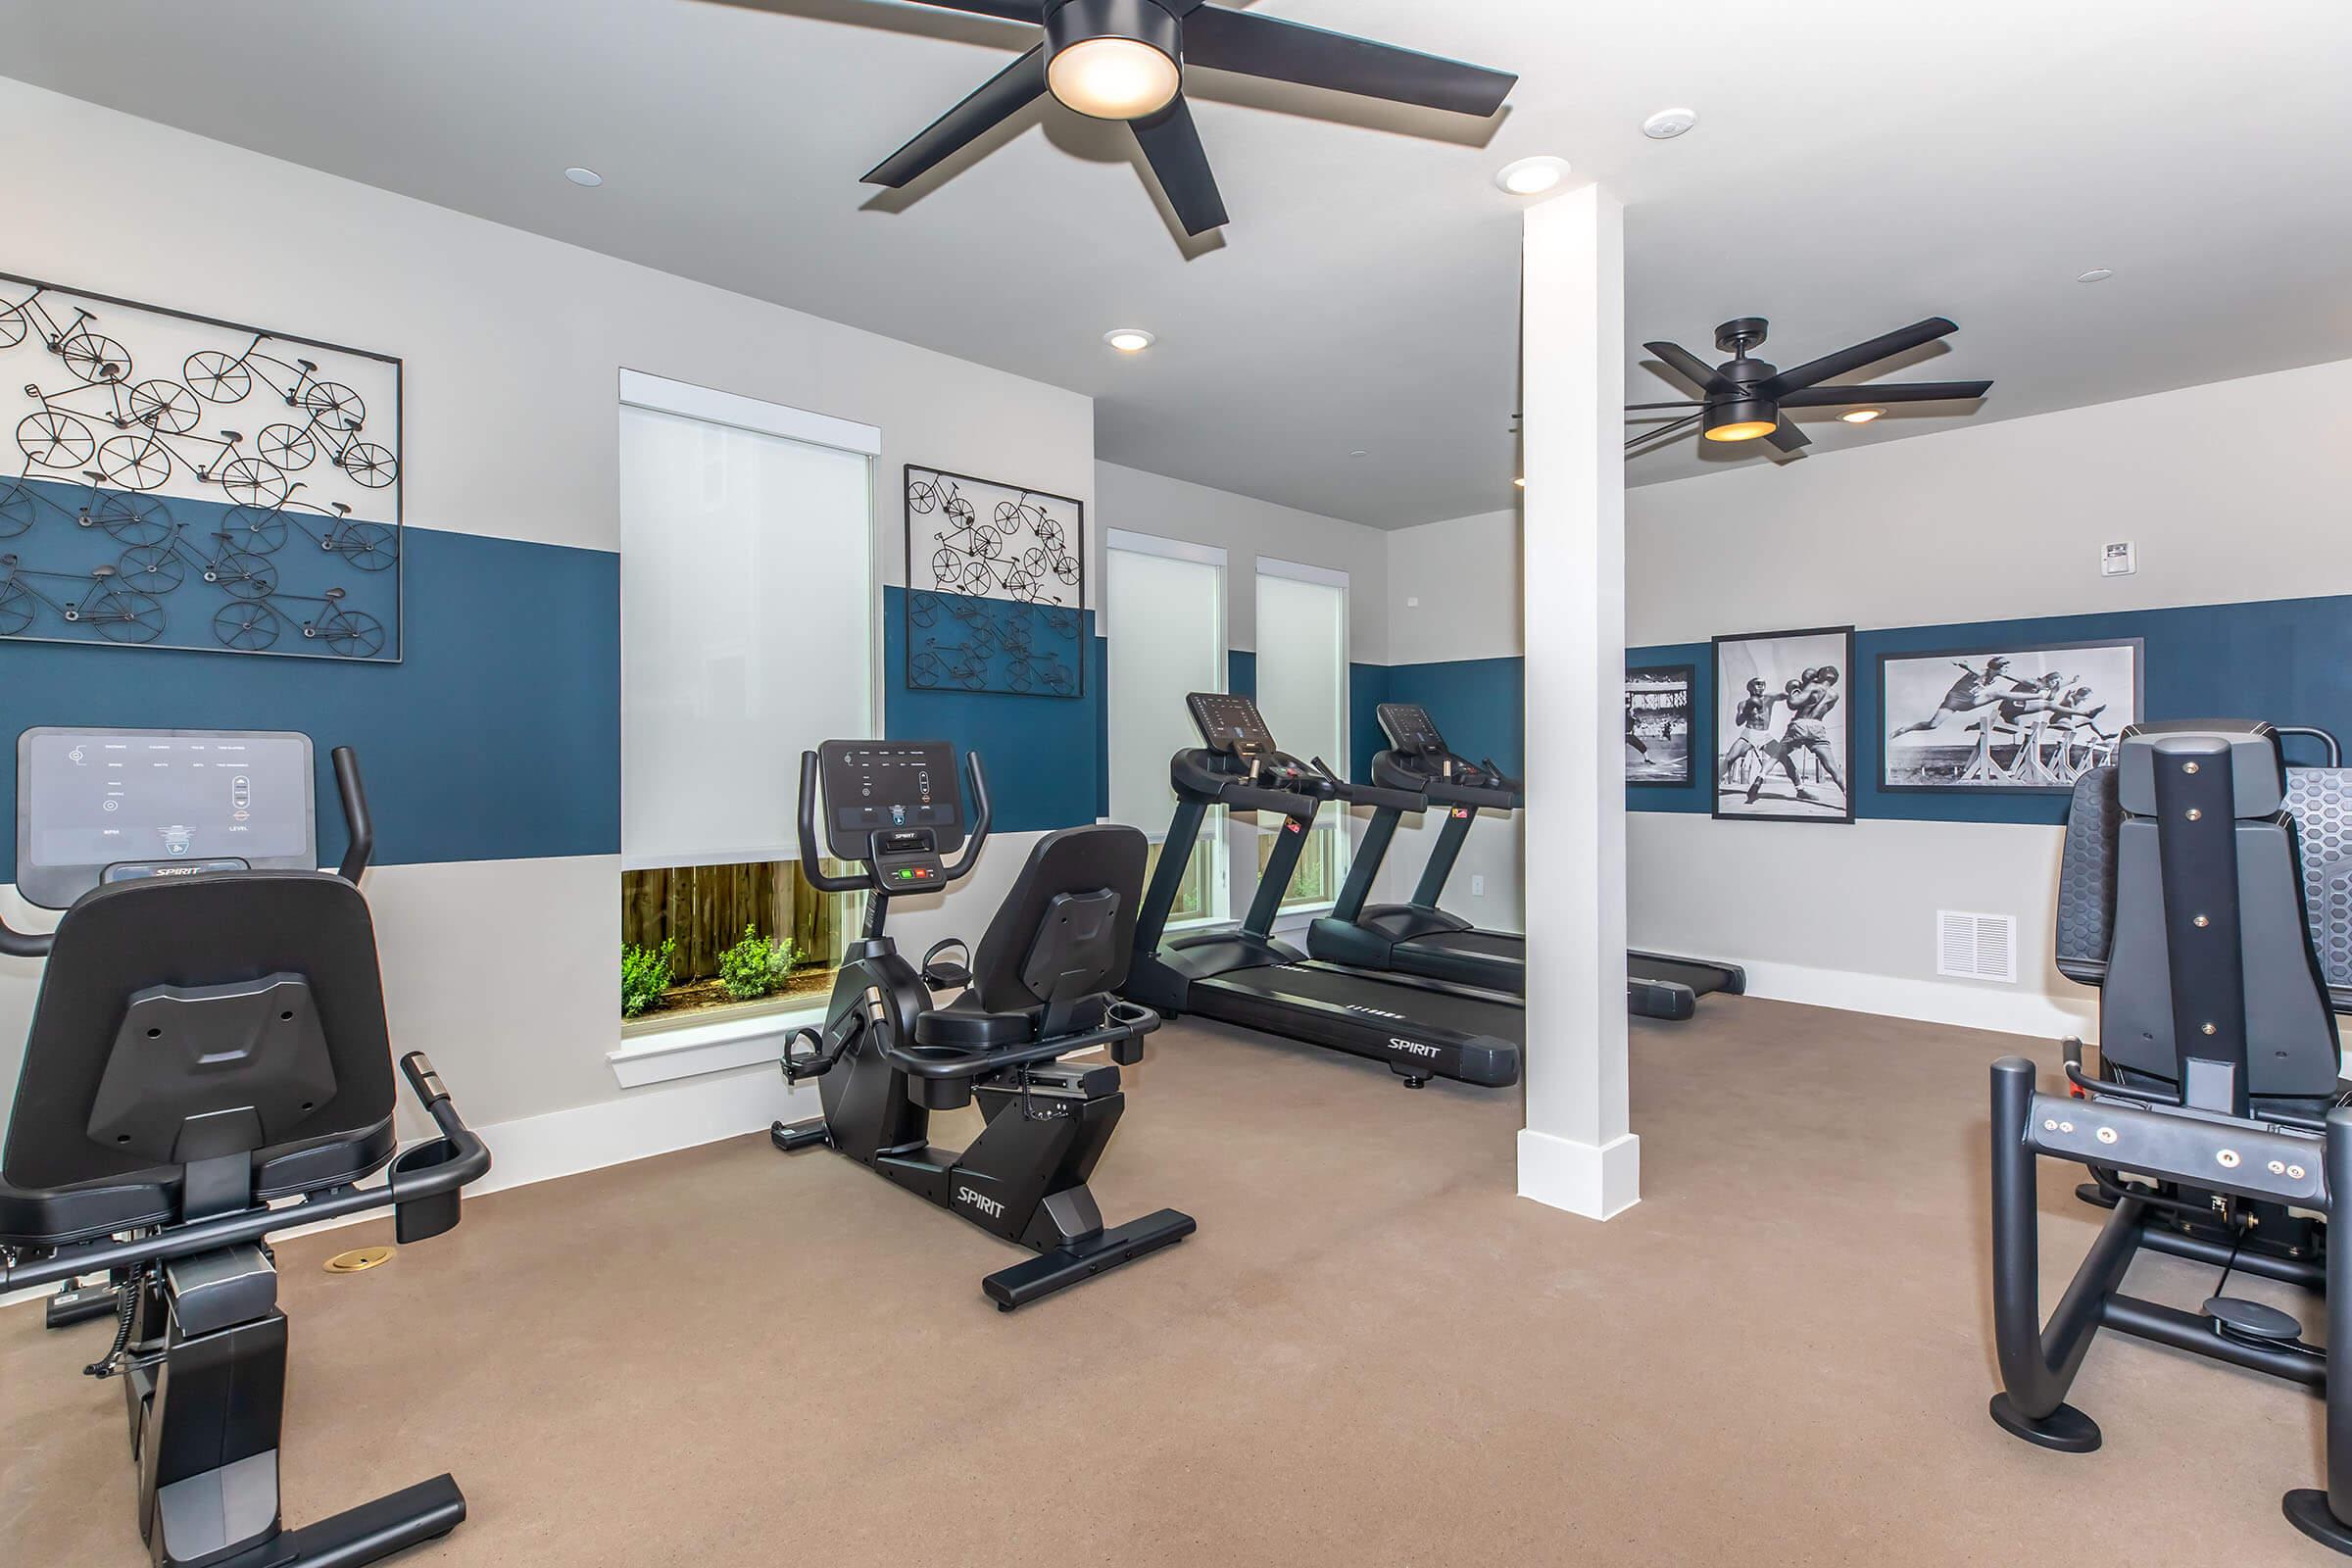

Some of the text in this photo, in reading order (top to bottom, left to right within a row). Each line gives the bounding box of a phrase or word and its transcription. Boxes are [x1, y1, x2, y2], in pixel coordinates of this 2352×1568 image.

[156, 867, 201, 876] SPIRIT
[1388, 1038, 1442, 1058] SPIRIT
[957, 1186, 1005, 1218] SPIRIT
